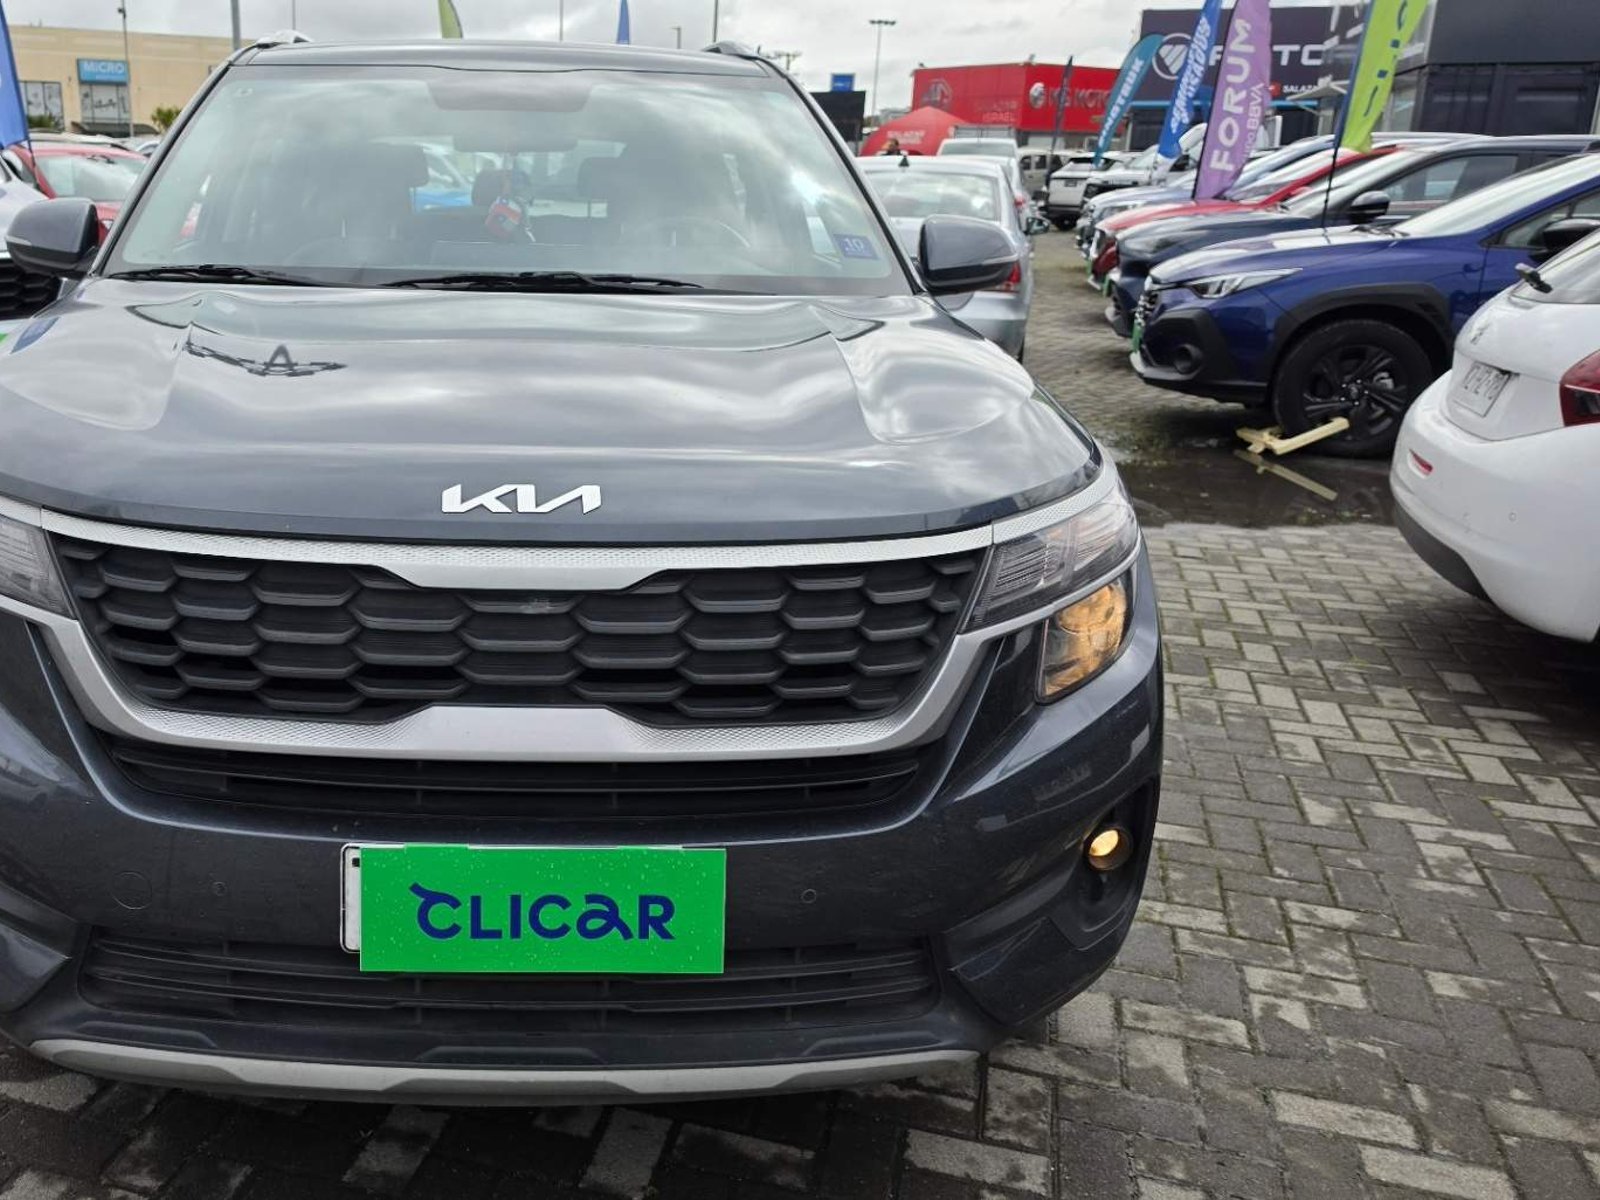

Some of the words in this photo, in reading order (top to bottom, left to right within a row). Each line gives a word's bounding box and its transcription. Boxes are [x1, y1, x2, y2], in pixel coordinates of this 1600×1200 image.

[83, 61, 125, 74] MICRO
[1098, 57, 1145, 148] SINOTRUK
[1209, 18, 1257, 172] FORUM
[1246, 82, 1265, 130] BBVA
[441, 484, 601, 514] KIA
[409, 882, 675, 941] CLICAR
